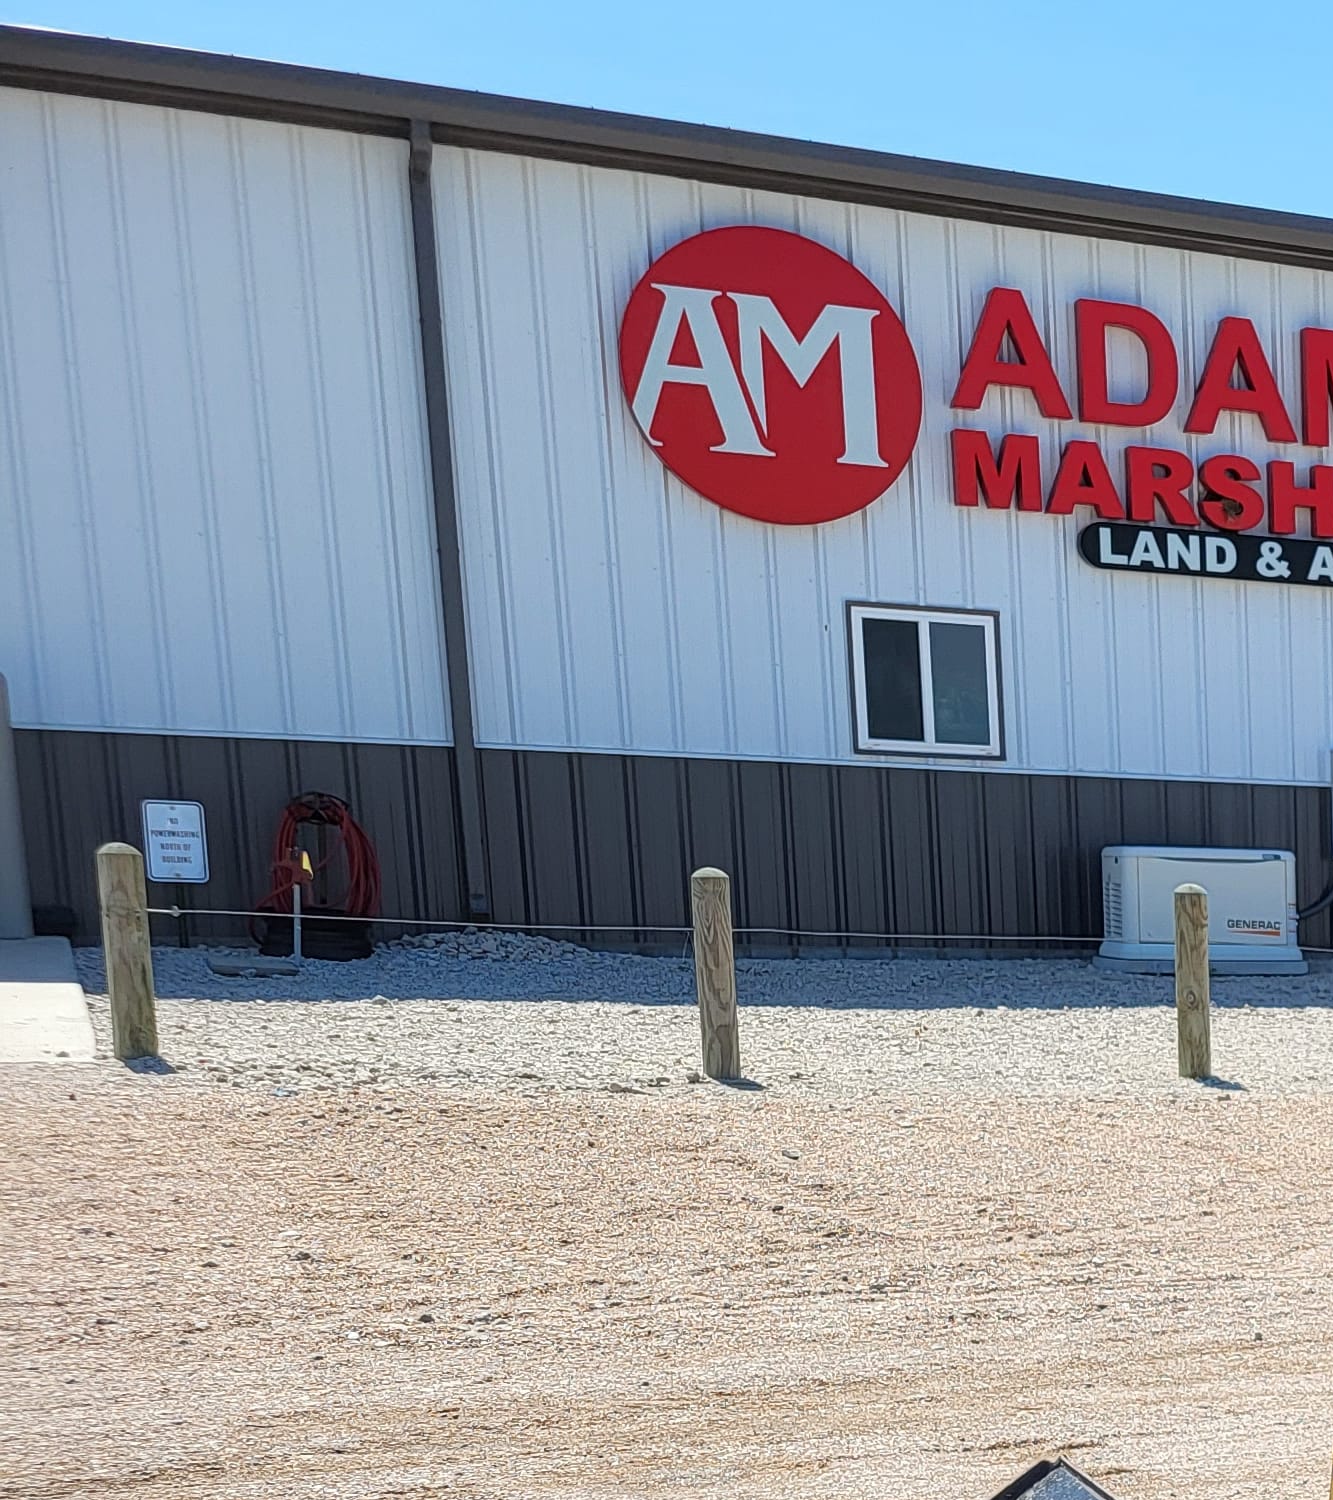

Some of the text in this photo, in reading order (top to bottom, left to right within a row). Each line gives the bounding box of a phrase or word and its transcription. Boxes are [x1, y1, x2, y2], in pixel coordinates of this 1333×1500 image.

[630, 282, 891, 469] AM
[1097, 526, 1238, 575] LAND
[1255, 540, 1291, 579] &
[1227, 919, 1281, 930] GENERAC
